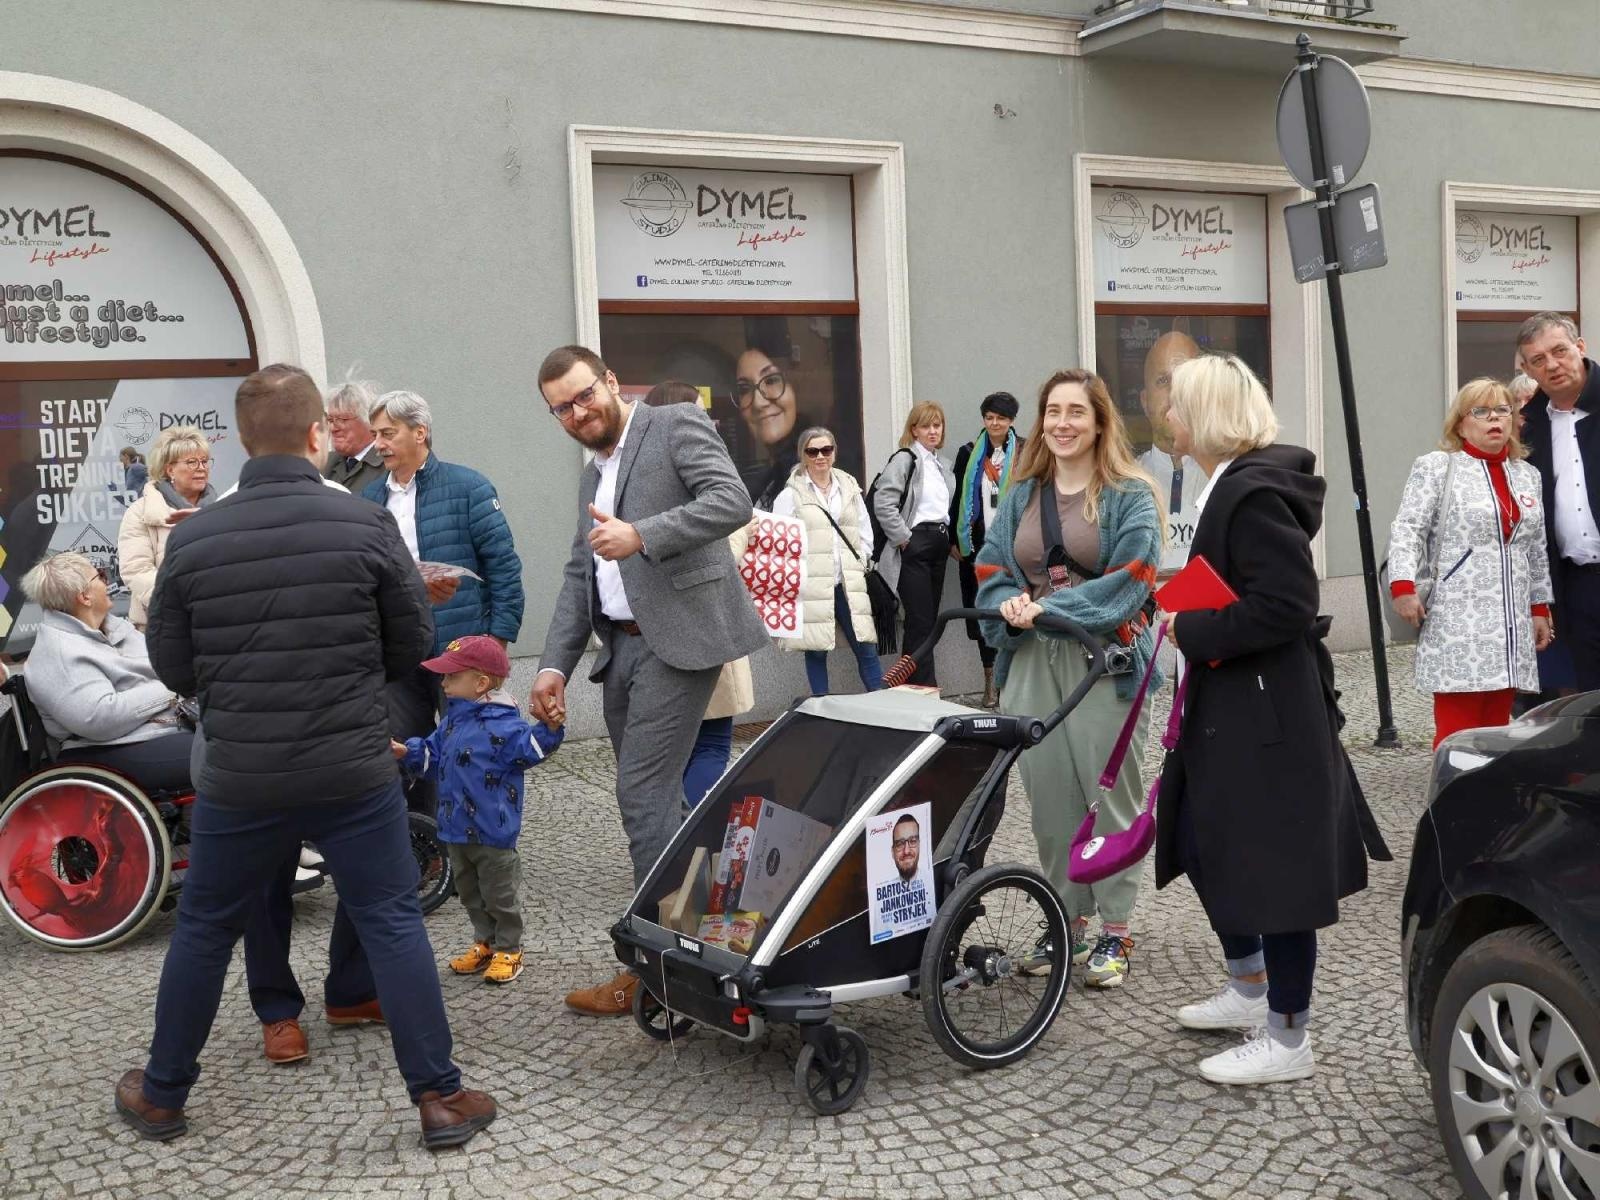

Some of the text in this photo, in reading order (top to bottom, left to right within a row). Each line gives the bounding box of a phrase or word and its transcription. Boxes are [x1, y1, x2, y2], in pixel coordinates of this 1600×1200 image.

[697, 184, 807, 221] DYMEL
[637, 218, 679, 235] STUDIO
[1152, 203, 1233, 235] DYMEL
[737, 226, 806, 250] Lifestyle
[1490, 224, 1552, 251] DYMEL
[30, 243, 110, 267] Lifestyle
[1181, 240, 1232, 261] Lifestyle
[70, 306, 89, 322] a
[98, 300, 184, 322] diet...
[5, 321, 146, 348] lifestyle.
[40, 398, 109, 424] START
[159, 409, 227, 431] DYMEL
[39, 427, 117, 458] DIETA
[36, 461, 126, 489] TRENING
[973, 719, 997, 728] THULE
[876, 881, 911, 901] BARTOSZ
[893, 901, 927, 924] STRYJEK
